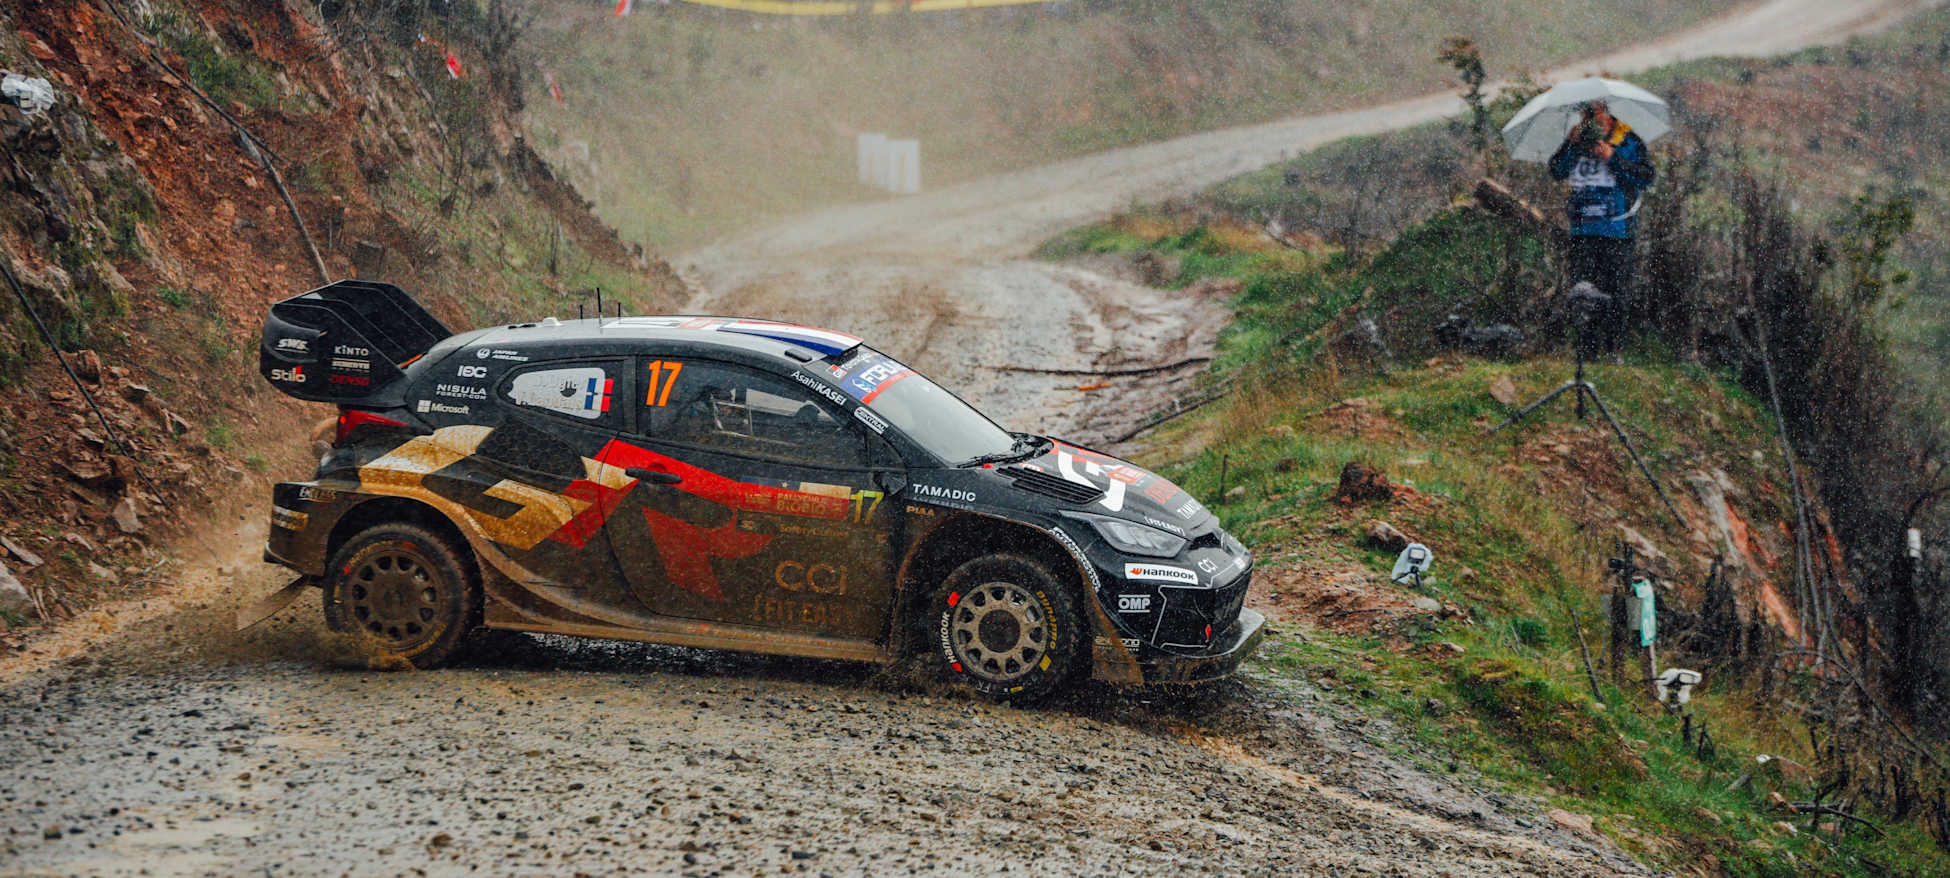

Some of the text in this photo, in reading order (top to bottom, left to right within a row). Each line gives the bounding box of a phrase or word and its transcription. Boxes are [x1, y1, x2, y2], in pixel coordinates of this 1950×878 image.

[334, 345, 369, 356] KINTO
[271, 365, 306, 383] Stilo
[436, 383, 487, 395] NISULA
[645, 359, 683, 407] 17
[431, 402, 470, 414] Microsoft
[912, 483, 977, 502] TAMADIC
[850, 489, 885, 525] 17
[1118, 597, 1150, 610] OMP
